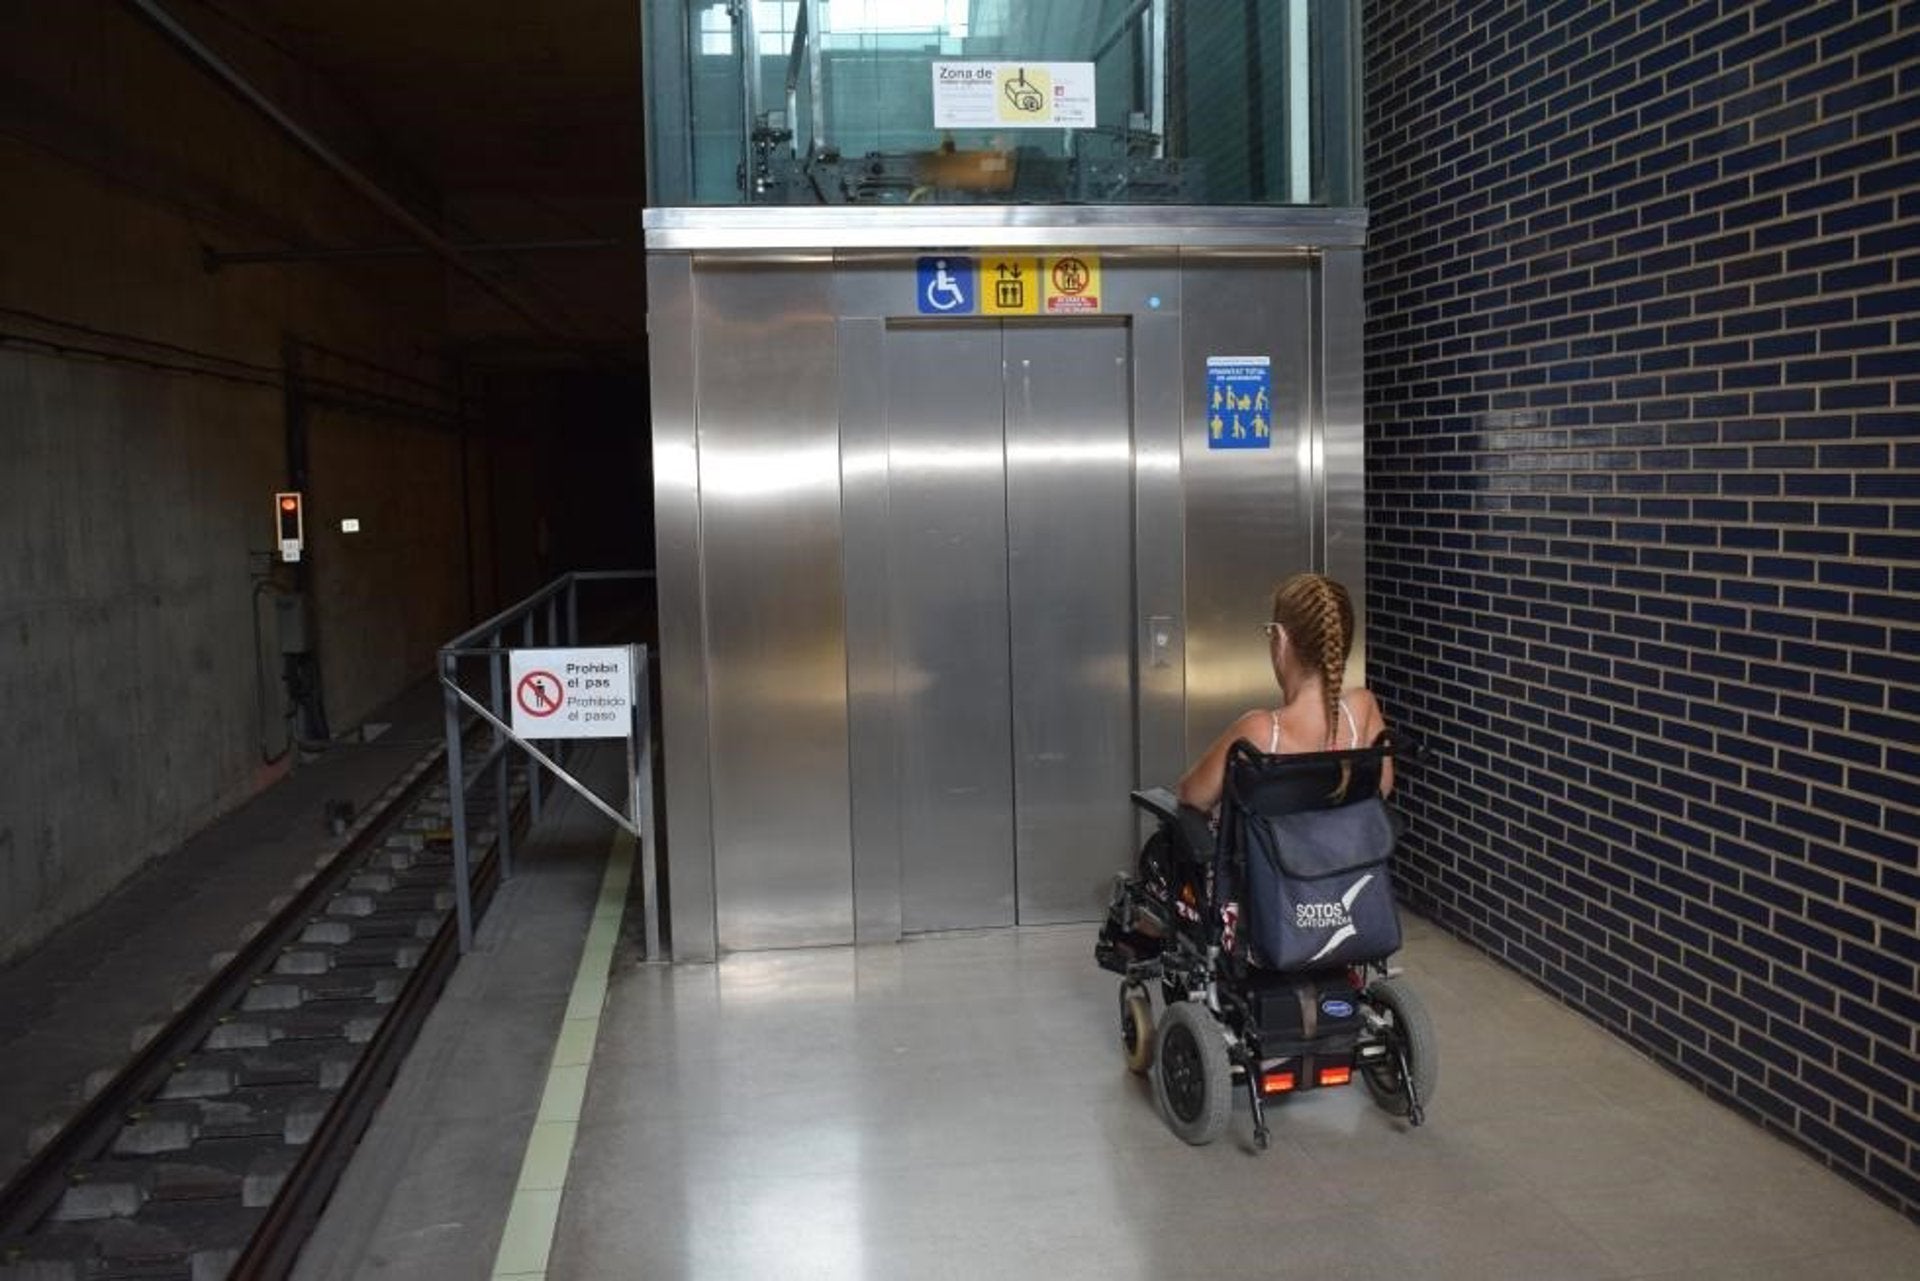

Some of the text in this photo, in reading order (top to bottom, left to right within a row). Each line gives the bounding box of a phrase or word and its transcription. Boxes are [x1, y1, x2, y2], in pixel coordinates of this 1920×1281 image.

[939, 66, 993, 79] Zona de
[566, 663, 618, 674] Prohibit
[567, 678, 610, 690] el pas
[567, 696, 626, 708] Prohibido
[567, 710, 616, 722] el paso
[1296, 902, 1343, 918] SOTOS
